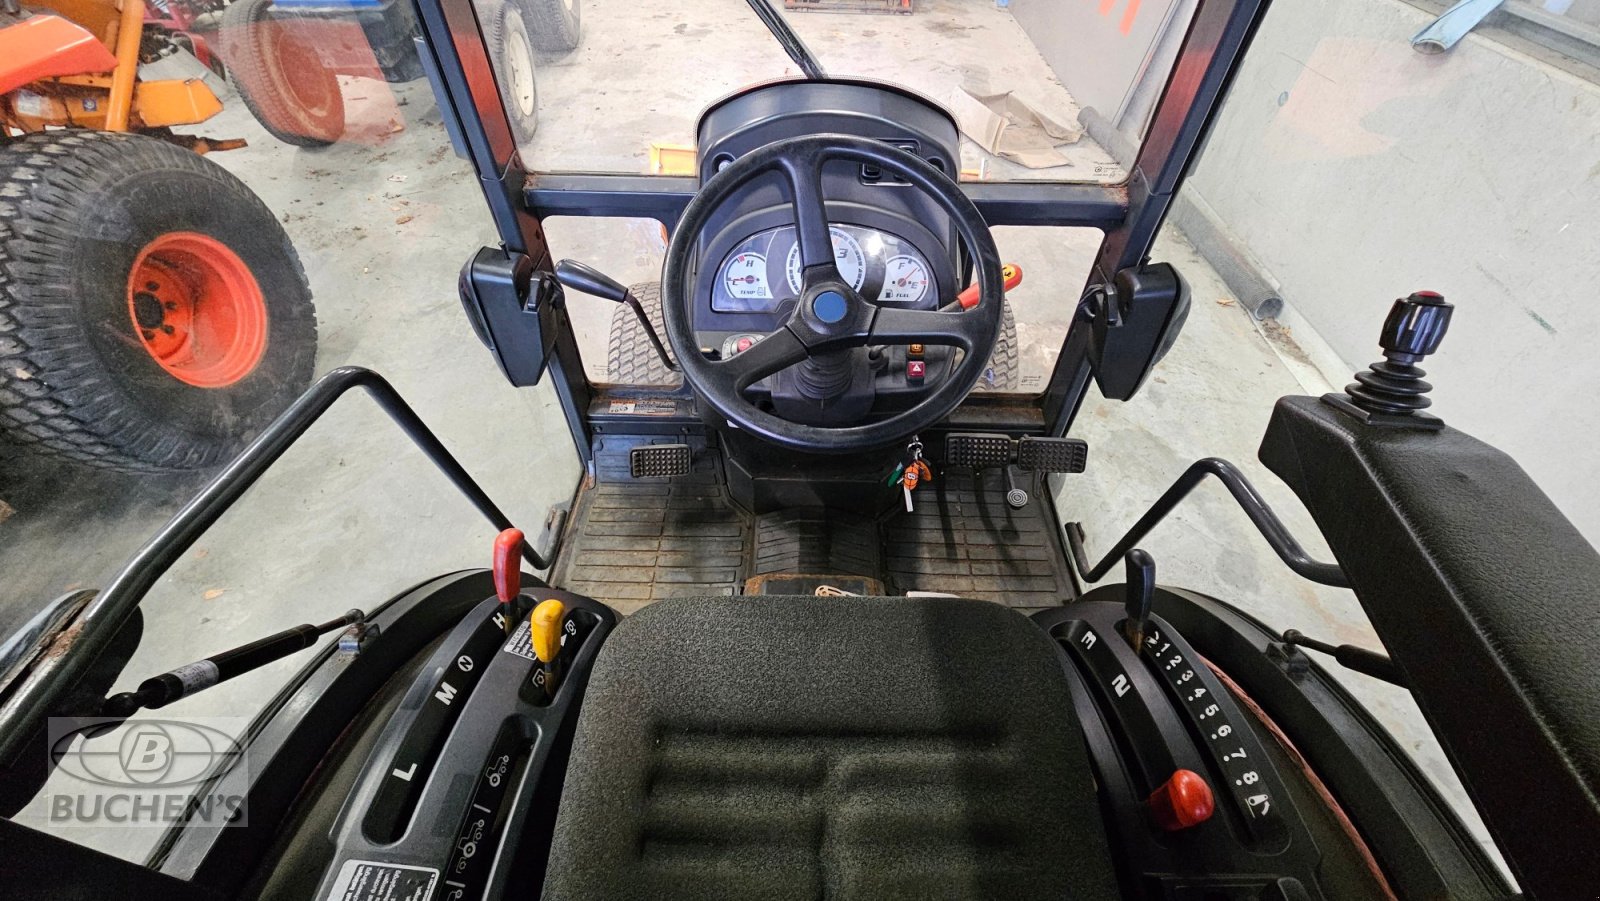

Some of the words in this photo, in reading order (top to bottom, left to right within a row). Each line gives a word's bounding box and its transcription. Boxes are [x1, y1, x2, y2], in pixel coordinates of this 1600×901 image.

[836, 248, 849, 259] 3
[745, 260, 754, 268] H
[897, 262, 906, 270] F
[910, 281, 919, 289] E
[492, 612, 505, 630] H
[1081, 630, 1097, 650] 3
[459, 656, 472, 670] N
[434, 681, 458, 706] M
[1111, 673, 1131, 698] 2
[1160, 643, 1171, 653] 1
[1170, 655, 1182, 667] 2
[1182, 670, 1194, 682] 3
[1194, 687, 1207, 698] 4
[1205, 703, 1220, 717] 5
[1217, 724, 1232, 737] 6
[1230, 747, 1247, 759] 7
[1242, 770, 1259, 785] 8
[392, 762, 418, 782] L
